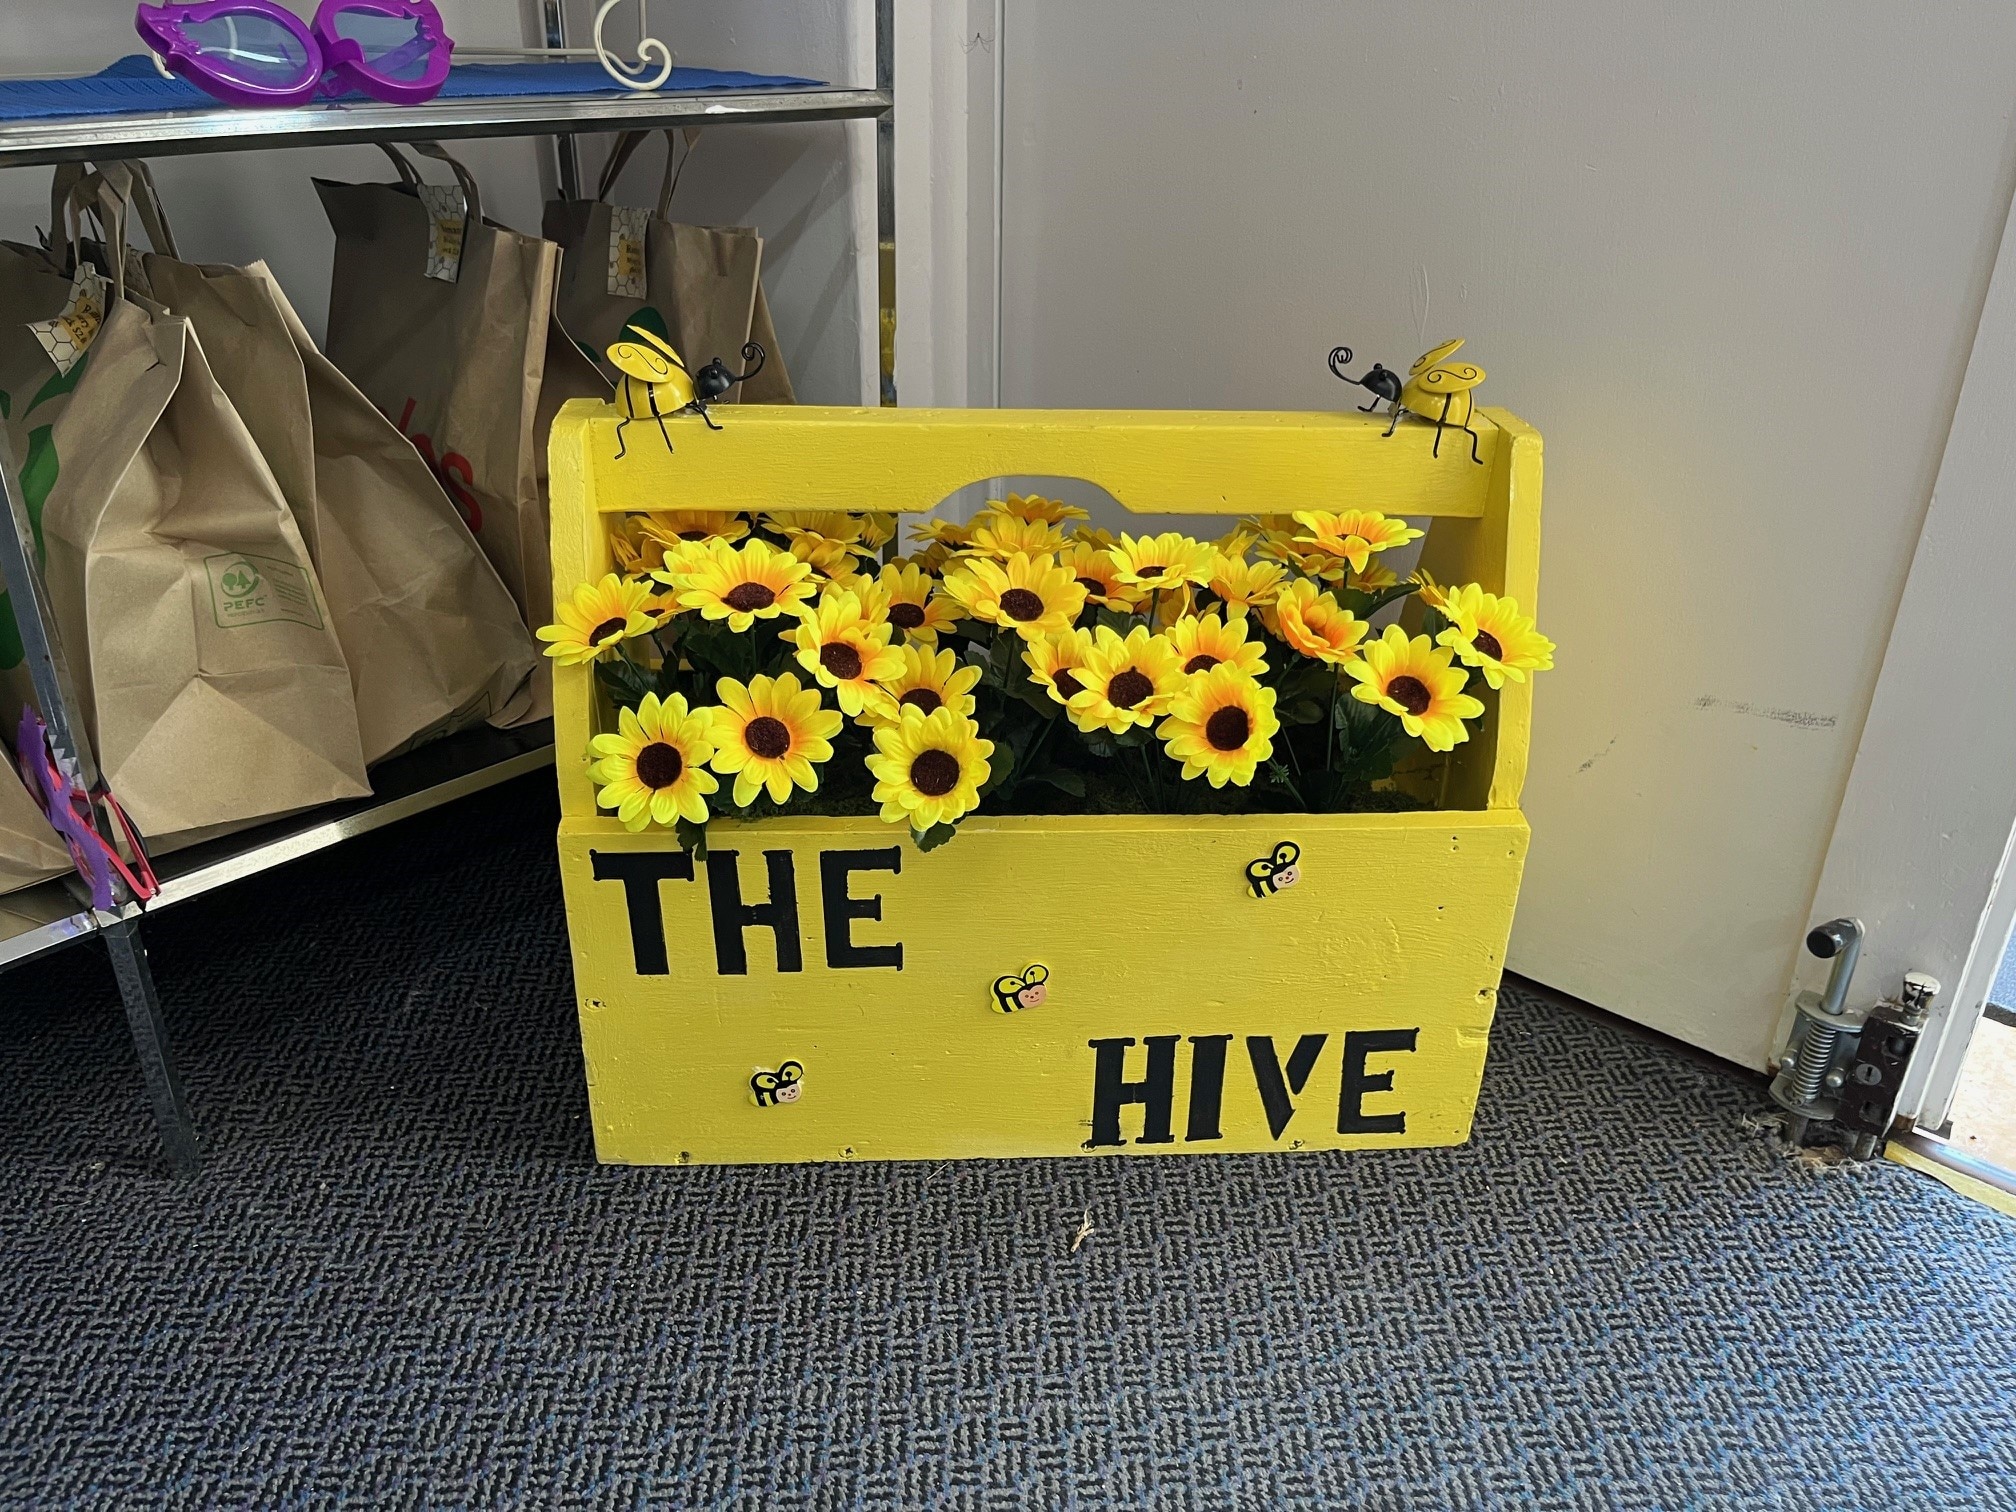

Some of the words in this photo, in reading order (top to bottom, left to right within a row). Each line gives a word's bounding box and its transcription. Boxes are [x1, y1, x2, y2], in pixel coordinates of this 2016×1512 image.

[223, 597, 265, 611] PEFC
[591, 849, 904, 975] THE
[1084, 1029, 1420, 1149] HIVE
